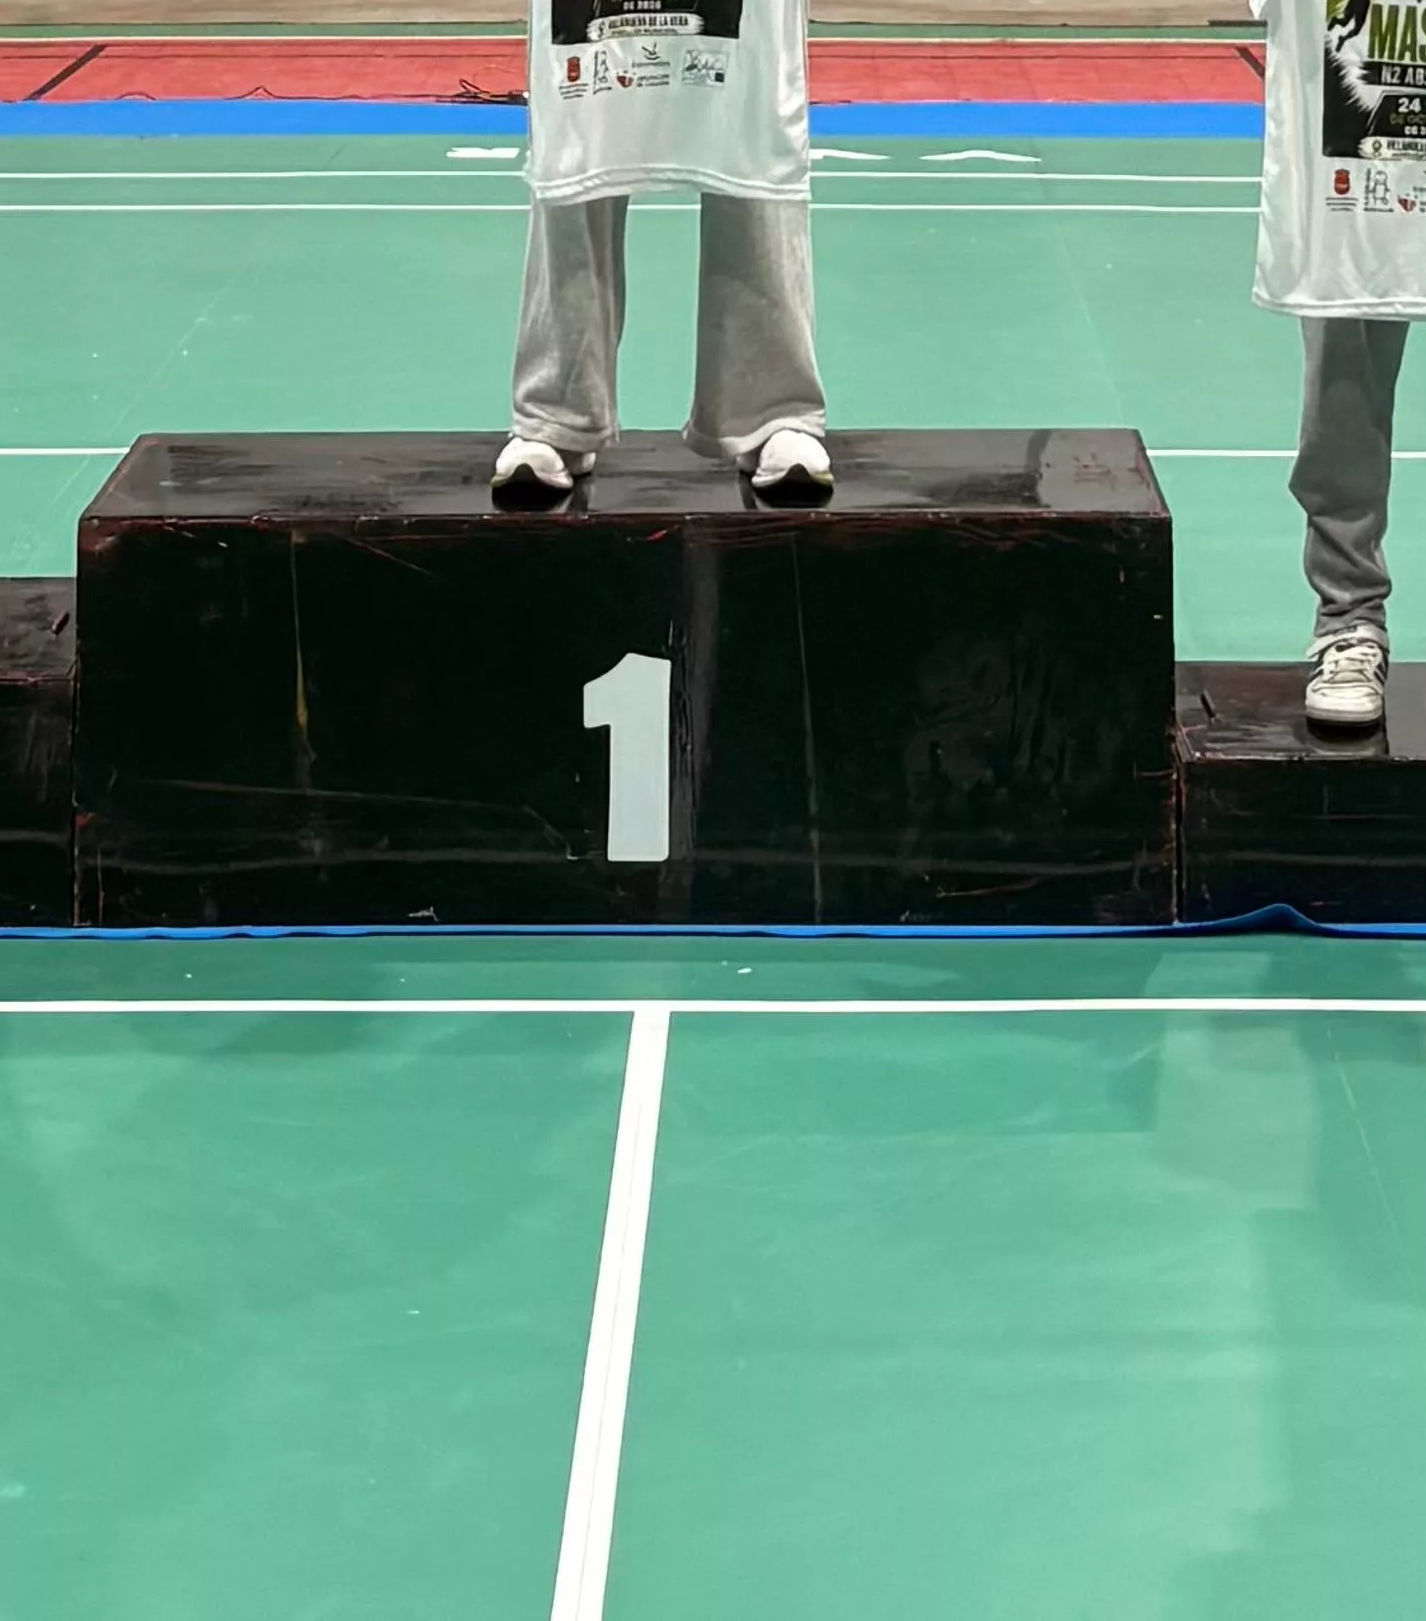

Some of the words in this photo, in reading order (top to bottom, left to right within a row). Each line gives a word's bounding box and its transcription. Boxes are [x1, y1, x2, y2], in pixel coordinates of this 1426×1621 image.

[1381, 66, 1401, 83] N2
[1398, 97, 1421, 113] 24
[581, 652, 671, 864] 1
